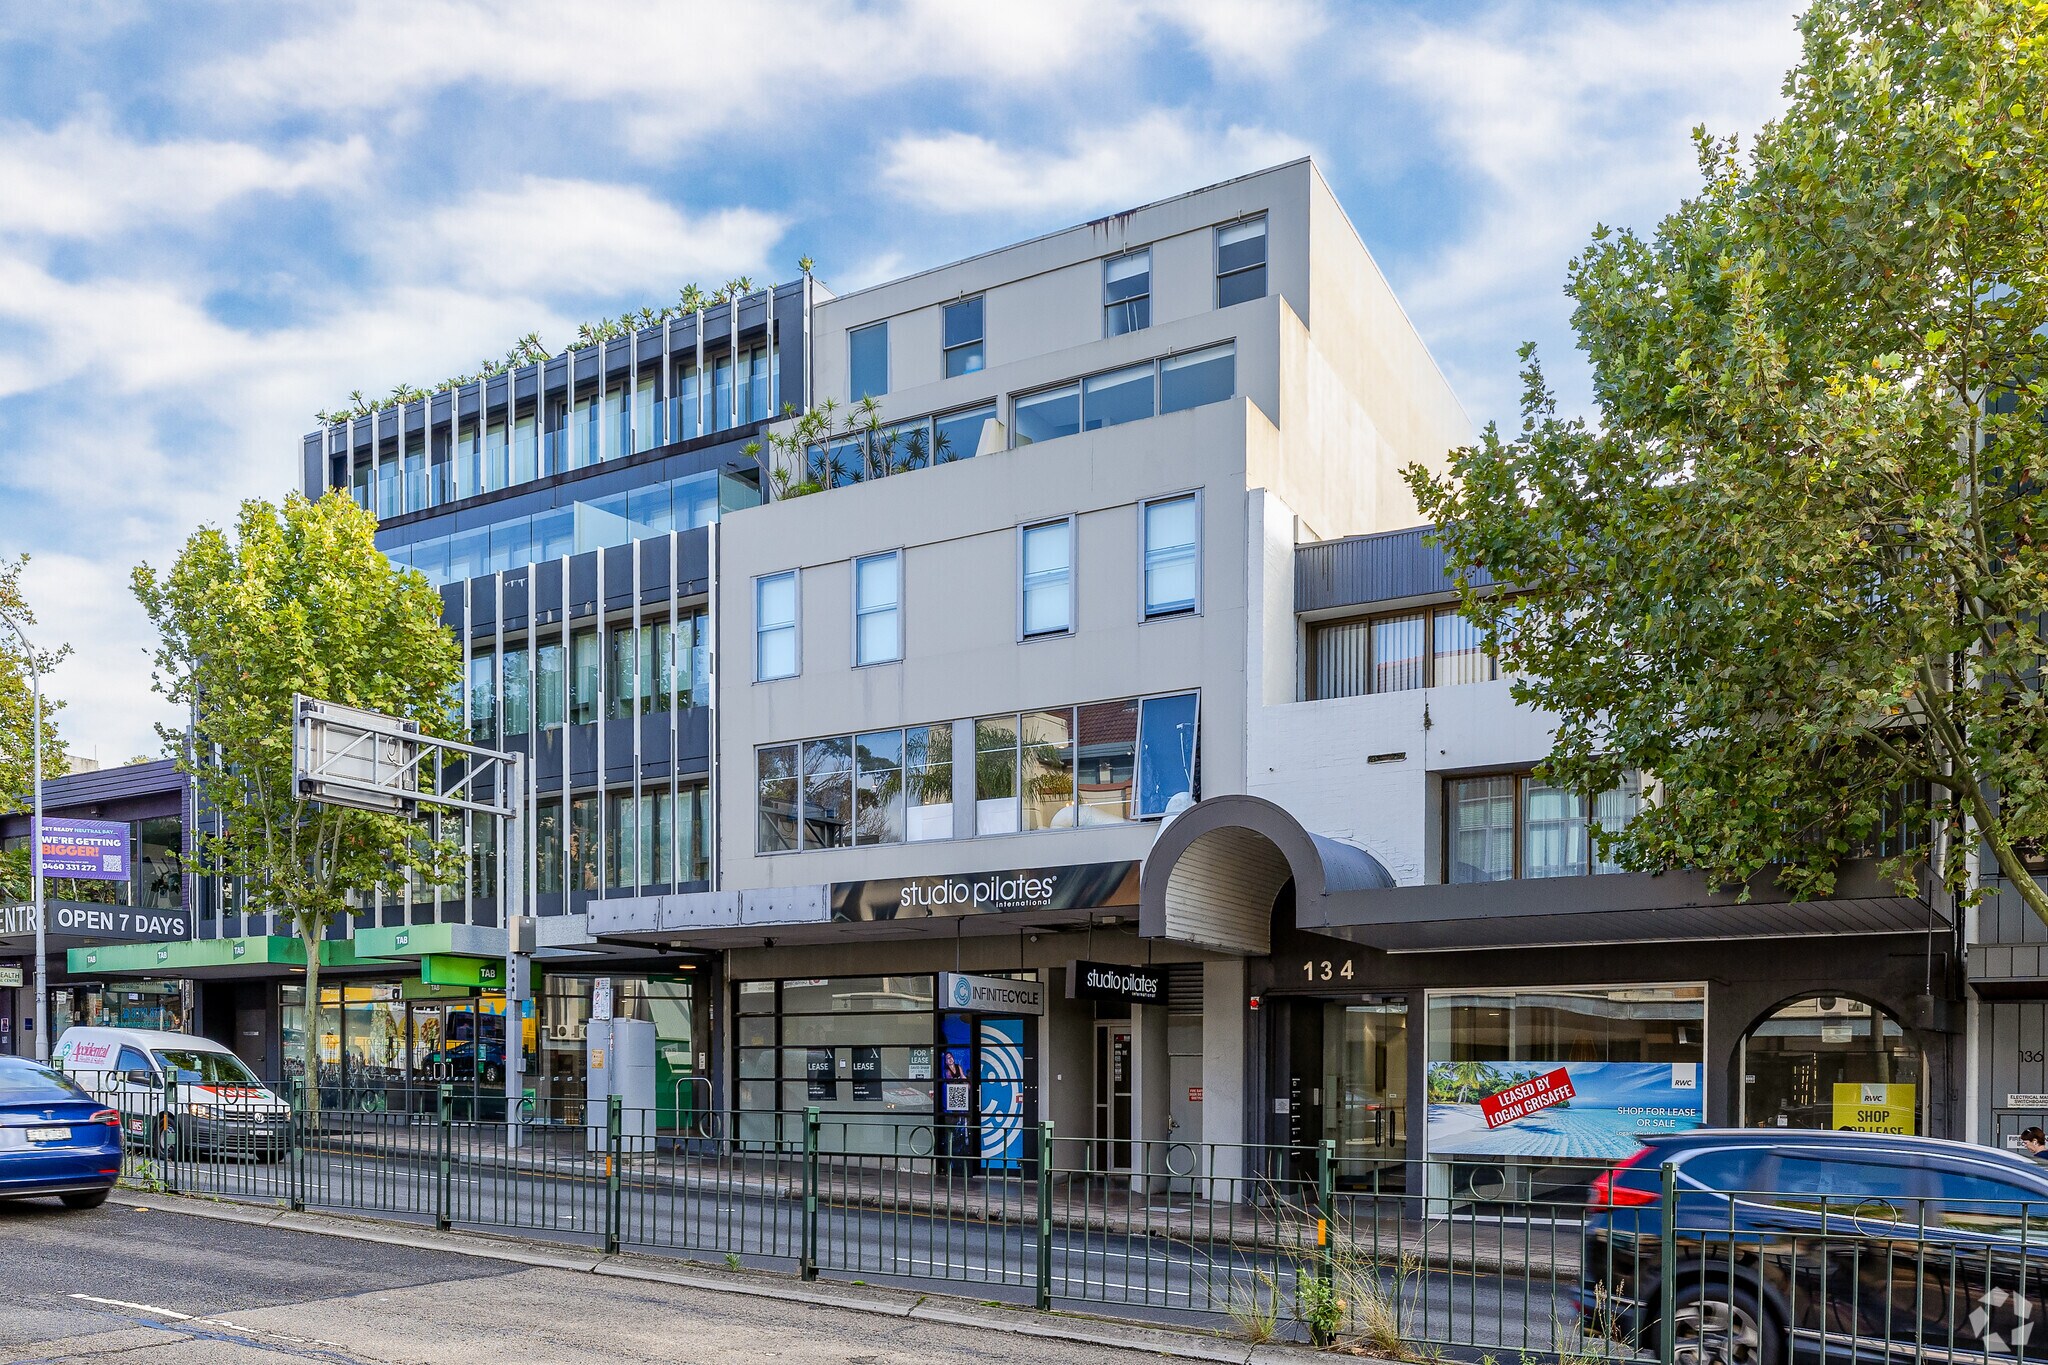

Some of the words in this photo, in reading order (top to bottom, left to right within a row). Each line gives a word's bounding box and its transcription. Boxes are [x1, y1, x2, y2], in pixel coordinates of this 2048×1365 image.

[41, 836, 74, 844] WE'RE
[75, 837, 121, 847] GETTING
[42, 844, 99, 857] BIGGER!
[900, 879, 969, 907] studio
[996, 899, 1051, 908] international
[0, 905, 46, 934] NTR
[57, 908, 113, 931] OPEN
[119, 913, 130, 931] 7
[135, 914, 185, 936] DAYS
[396, 936, 408, 944] TAB
[157, 951, 167, 959] TAB
[234, 946, 244, 954] TAB
[480, 968, 496, 978] TAB
[1303, 959, 1355, 981] 134
[1087, 968, 1121, 990] studio
[972, 986, 1039, 1005] INFINITECYCLE
[913, 1049, 927, 1057] FOR
[2019, 1050, 2044, 1063] 136
[807, 1062, 829, 1071] LEASE
[853, 1062, 875, 1070] LEASE
[1498, 1083, 1536, 1107] LEASED
[1535, 1076, 1551, 1092] BY
[1489, 1103, 1524, 1126] LOGAN
[1523, 1084, 1573, 1113] GRISAFFE
[1617, 1107, 1644, 1115] SHOP
[1645, 1107, 1665, 1116] FOR
[1667, 1108, 1696, 1117] LEASE
[1857, 1110, 1890, 1123] SHOP
[1637, 1119, 1651, 1127] OR
[1652, 1119, 1676, 1128] SALE
